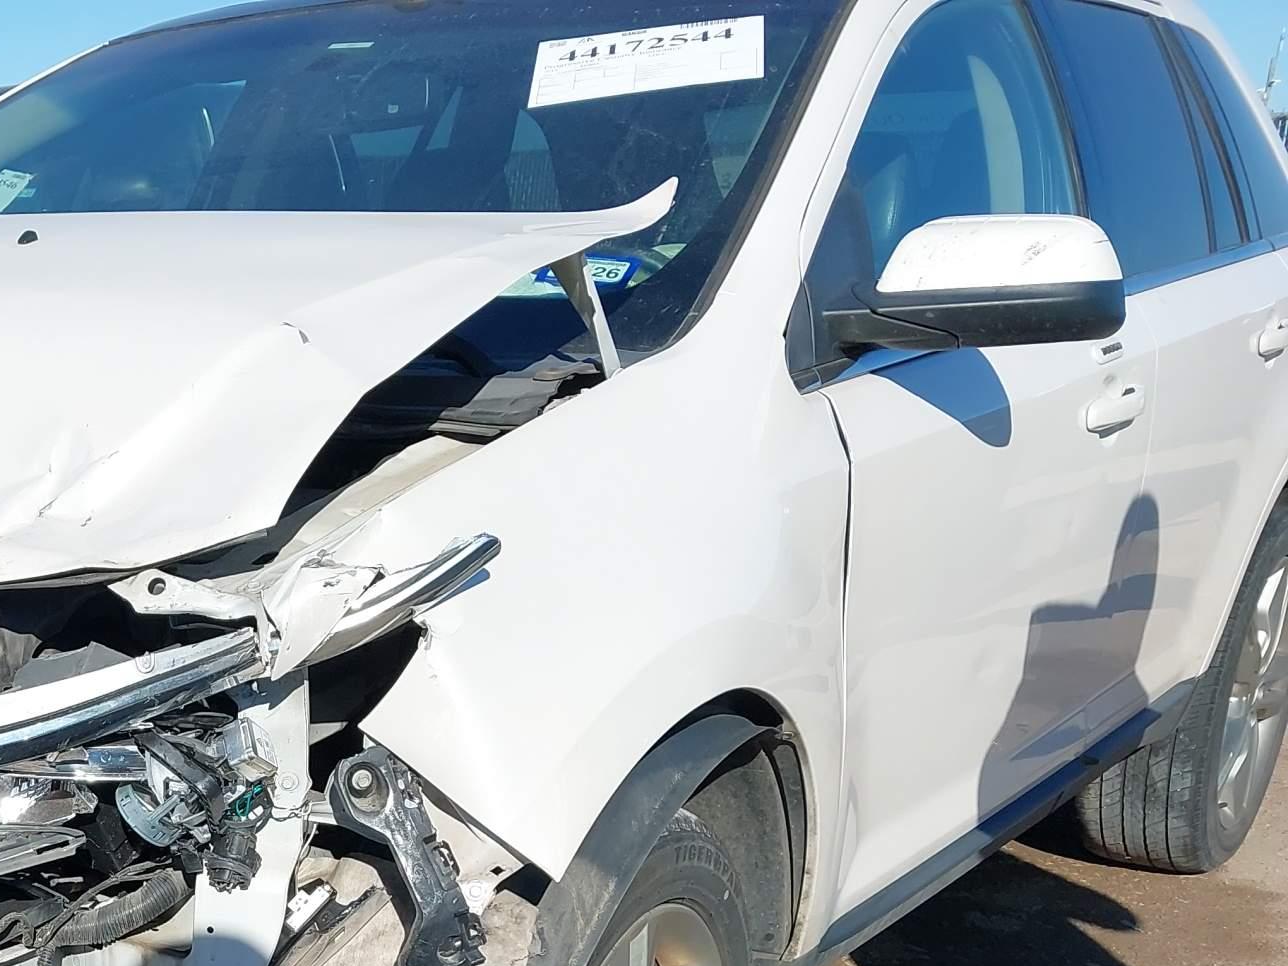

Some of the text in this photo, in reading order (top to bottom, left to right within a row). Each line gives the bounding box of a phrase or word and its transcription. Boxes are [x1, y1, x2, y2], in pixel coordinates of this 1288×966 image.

[559, 27, 734, 61] 44172544
[591, 266, 621, 279] 26
[674, 843, 713, 866] TIGER
